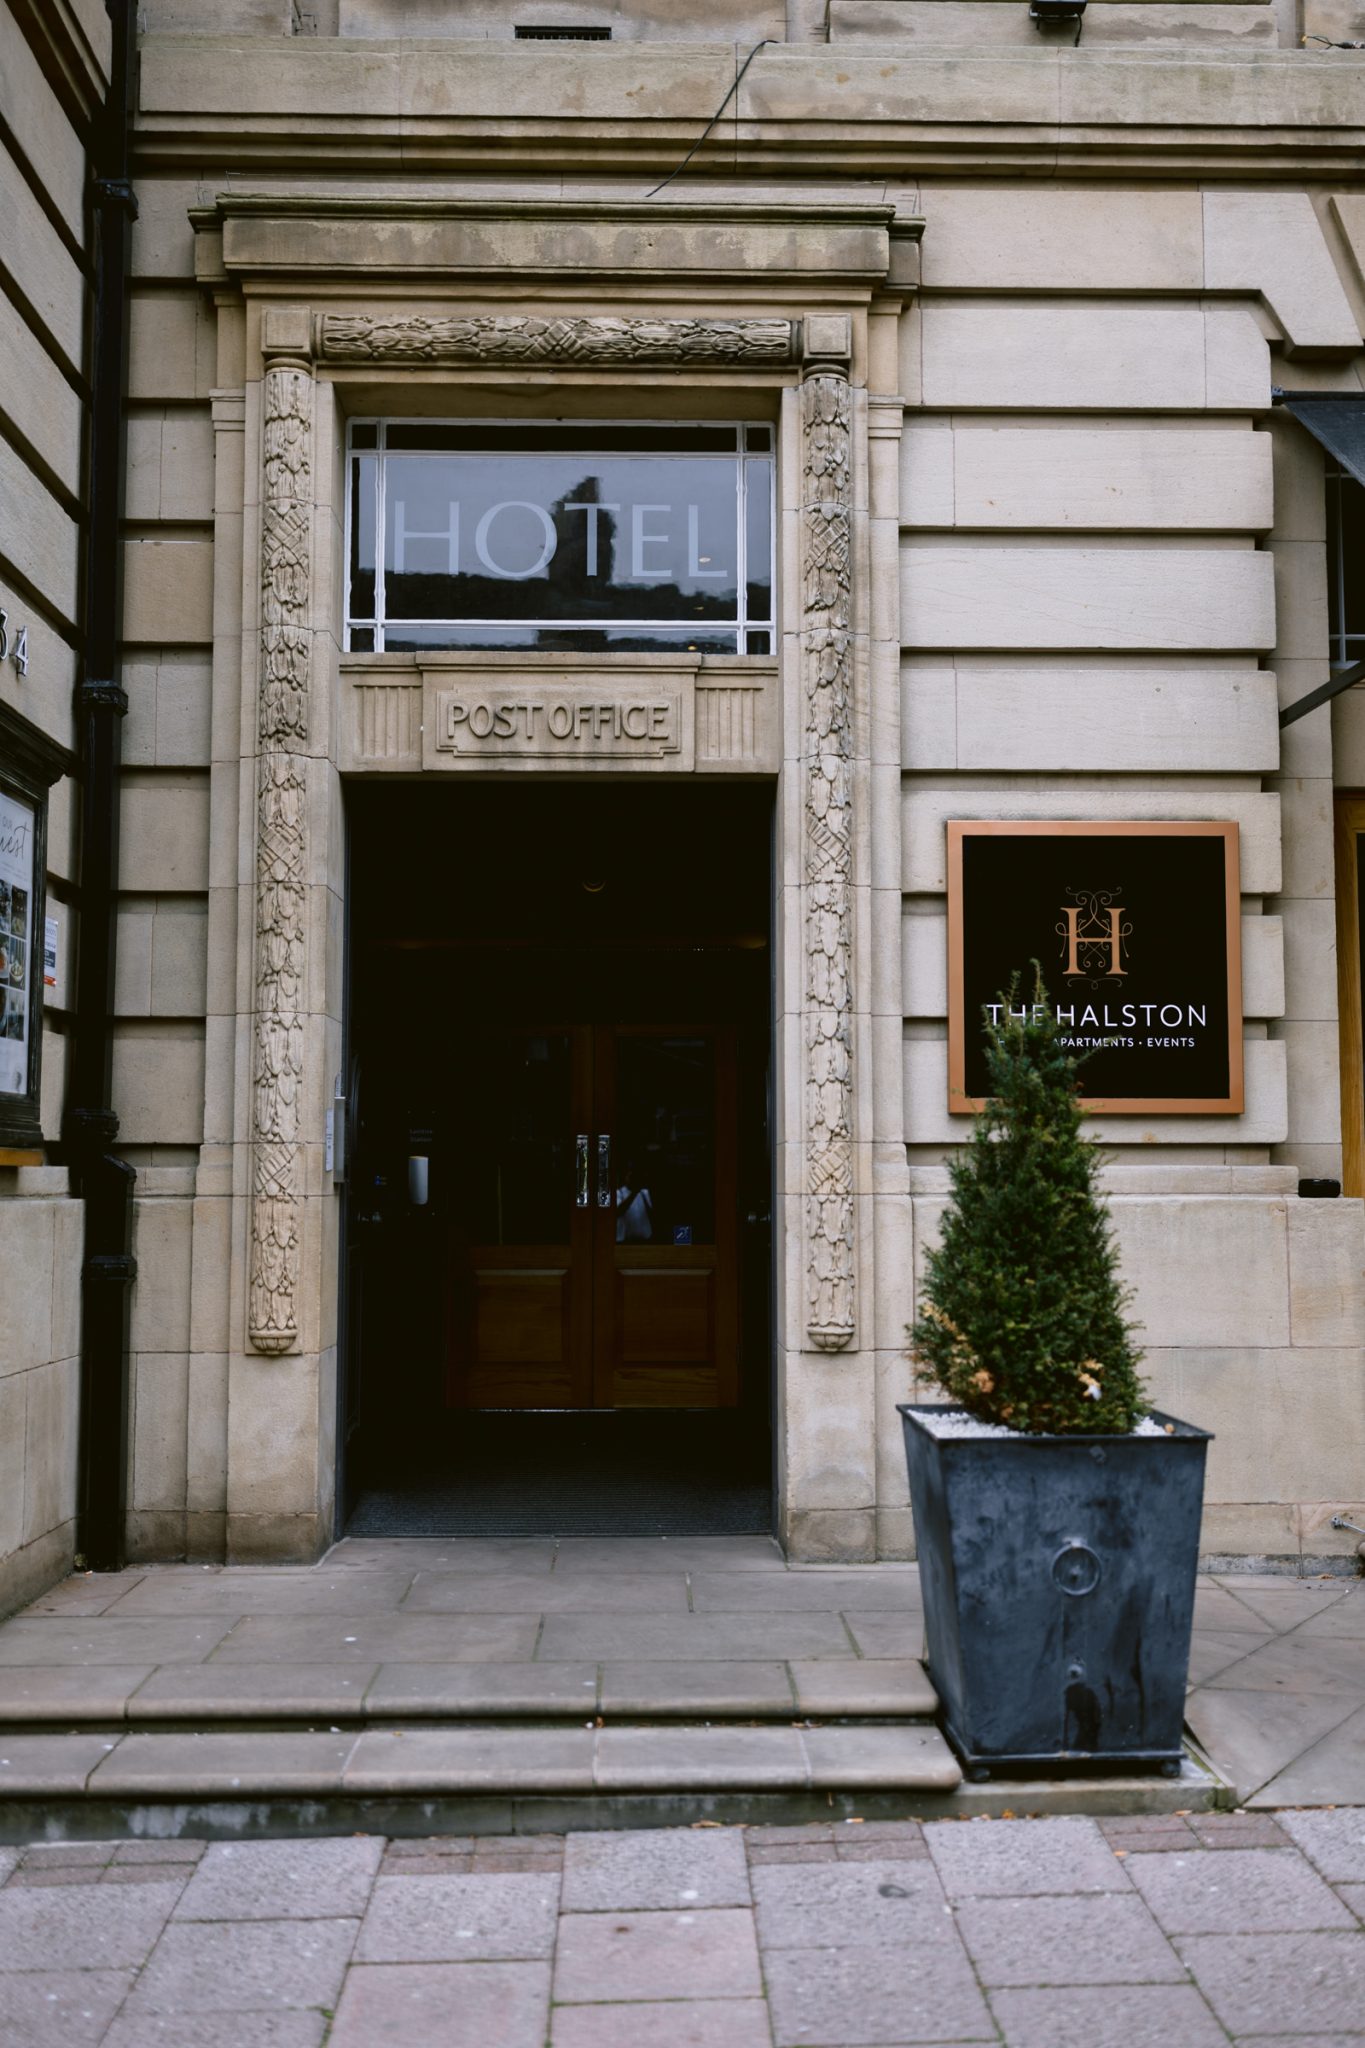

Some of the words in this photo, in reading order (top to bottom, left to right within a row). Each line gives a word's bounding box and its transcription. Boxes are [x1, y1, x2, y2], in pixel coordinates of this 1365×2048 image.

[394, 500, 728, 579] HOTEL
[447, 702, 543, 740] POST
[549, 702, 669, 740] OFFICE
[1060, 907, 1129, 975] H
[985, 1004, 1045, 1027] THE
[1056, 1004, 1207, 1028] HALSTON
[1146, 1037, 1195, 1048] EVENTS
